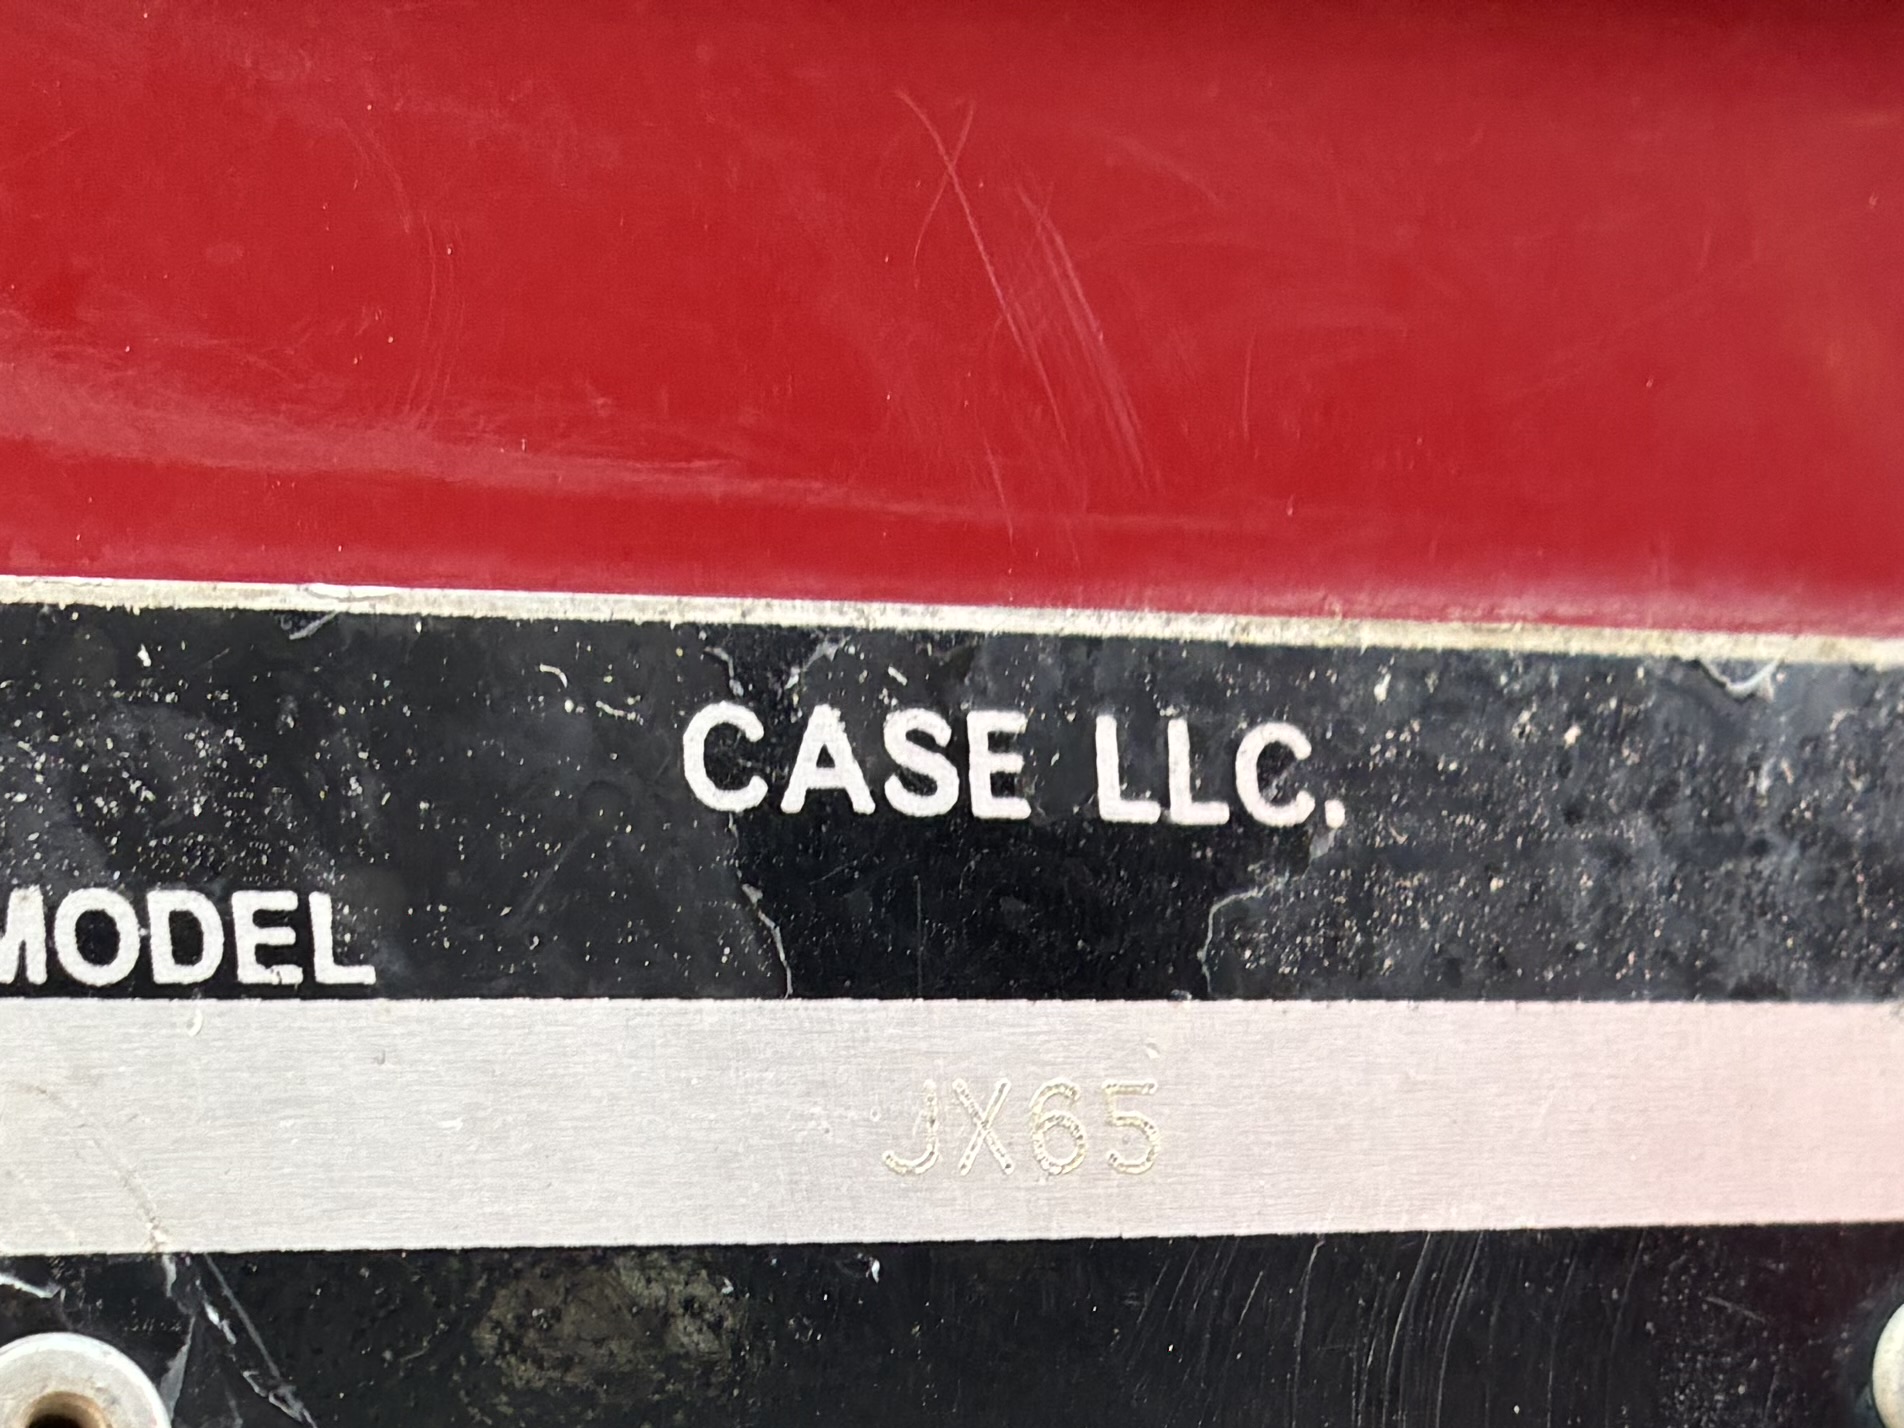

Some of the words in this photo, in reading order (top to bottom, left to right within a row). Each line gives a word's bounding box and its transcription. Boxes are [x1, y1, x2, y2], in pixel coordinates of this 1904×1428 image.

[683, 700, 1025, 824] CASE
[1096, 714, 1344, 832] LLC.
[880, 1075, 1163, 1177] JX65
